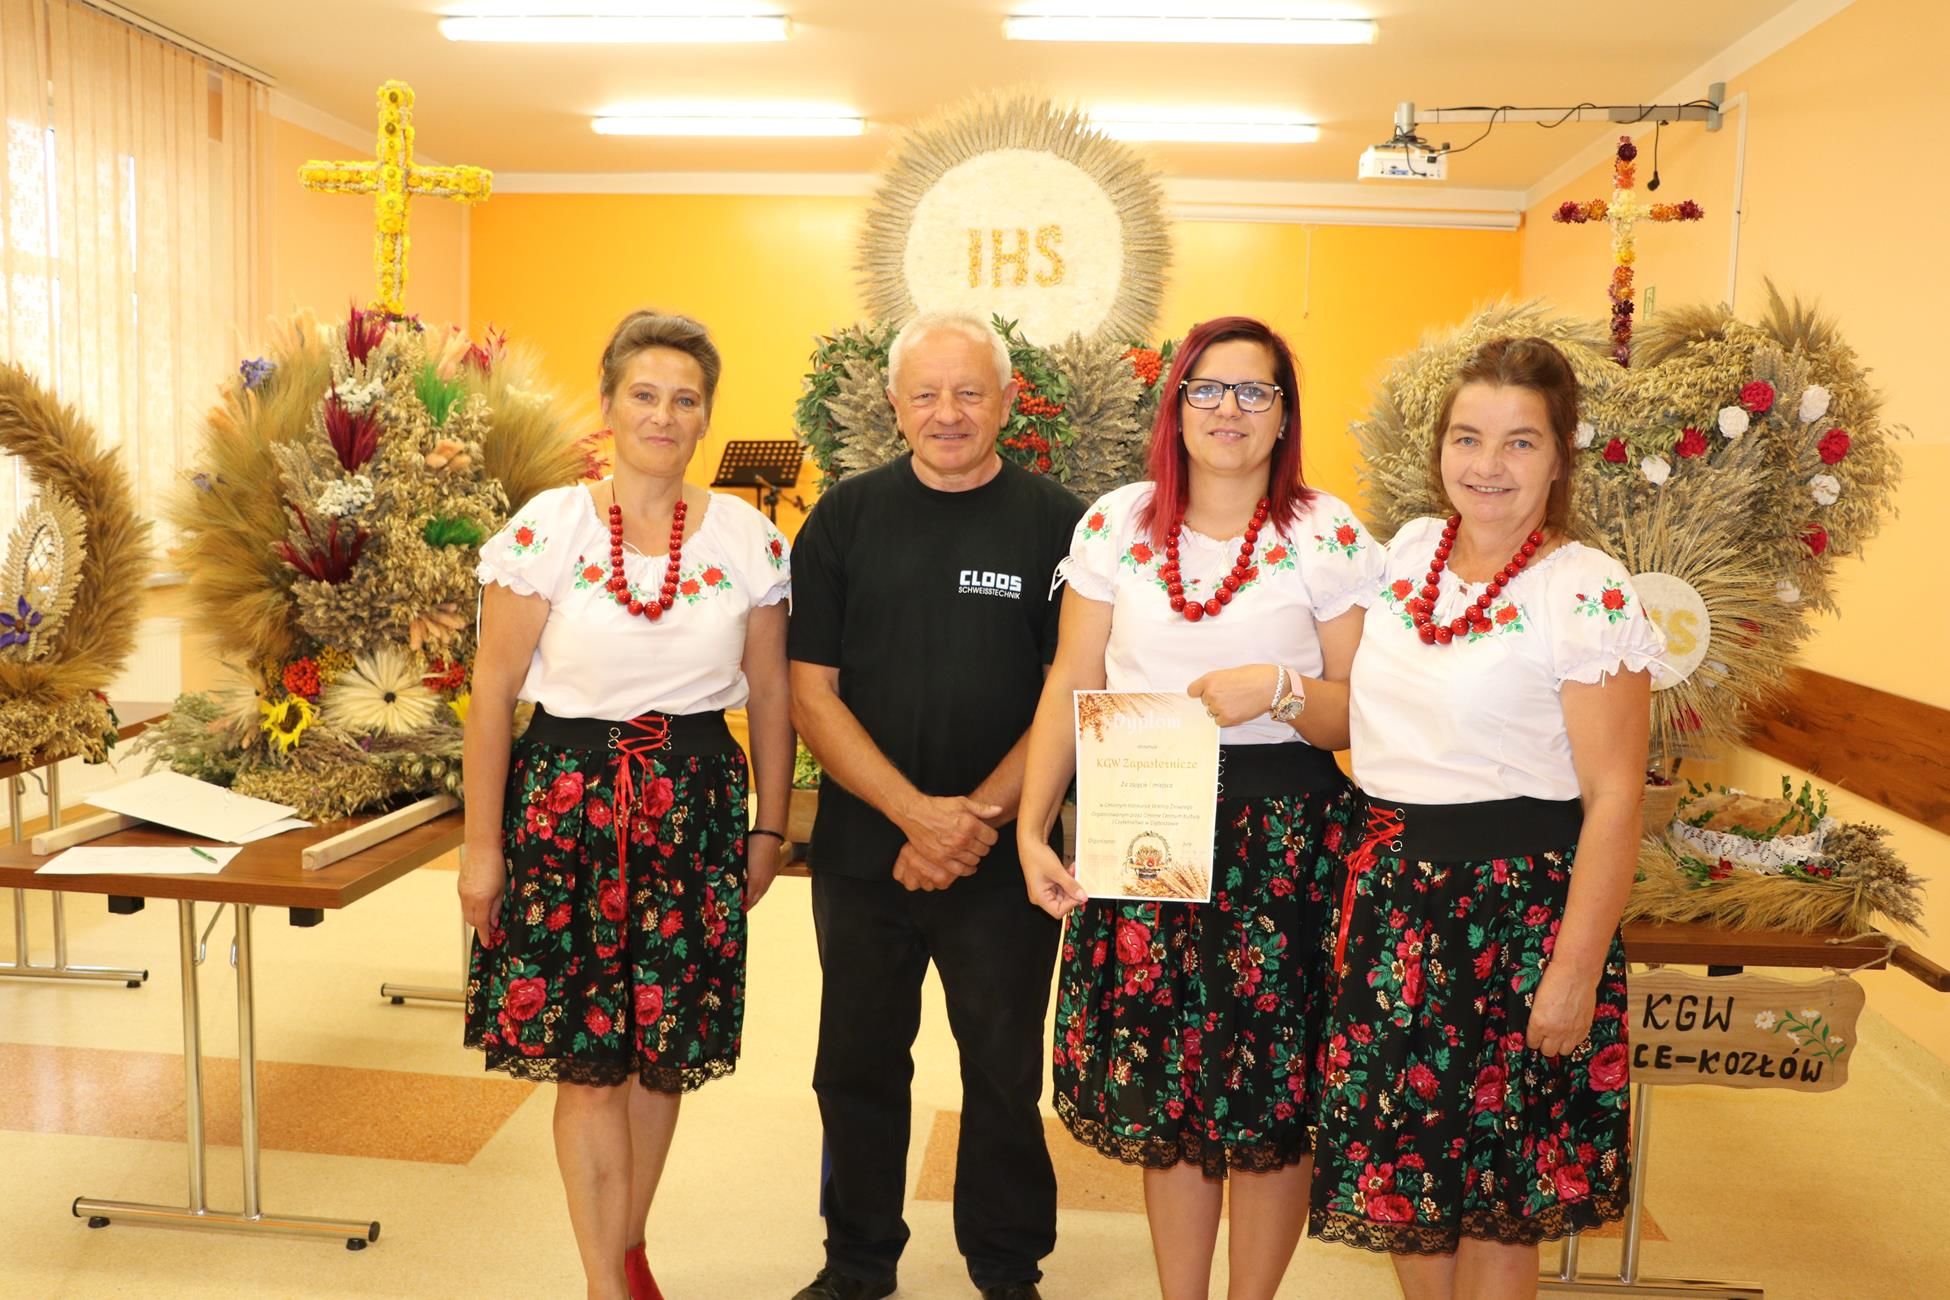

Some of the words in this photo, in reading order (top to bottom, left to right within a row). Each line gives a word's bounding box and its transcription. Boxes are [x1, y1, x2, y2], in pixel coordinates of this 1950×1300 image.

[967, 223, 1066, 289] IHS
[958, 586, 1021, 599] SCHWEISSTECHNIK
[959, 569, 1022, 592] CLOOS
[1113, 709, 1181, 734] Dyplom
[1096, 758, 1120, 769] KGW
[1643, 993, 1735, 1032] KGW
